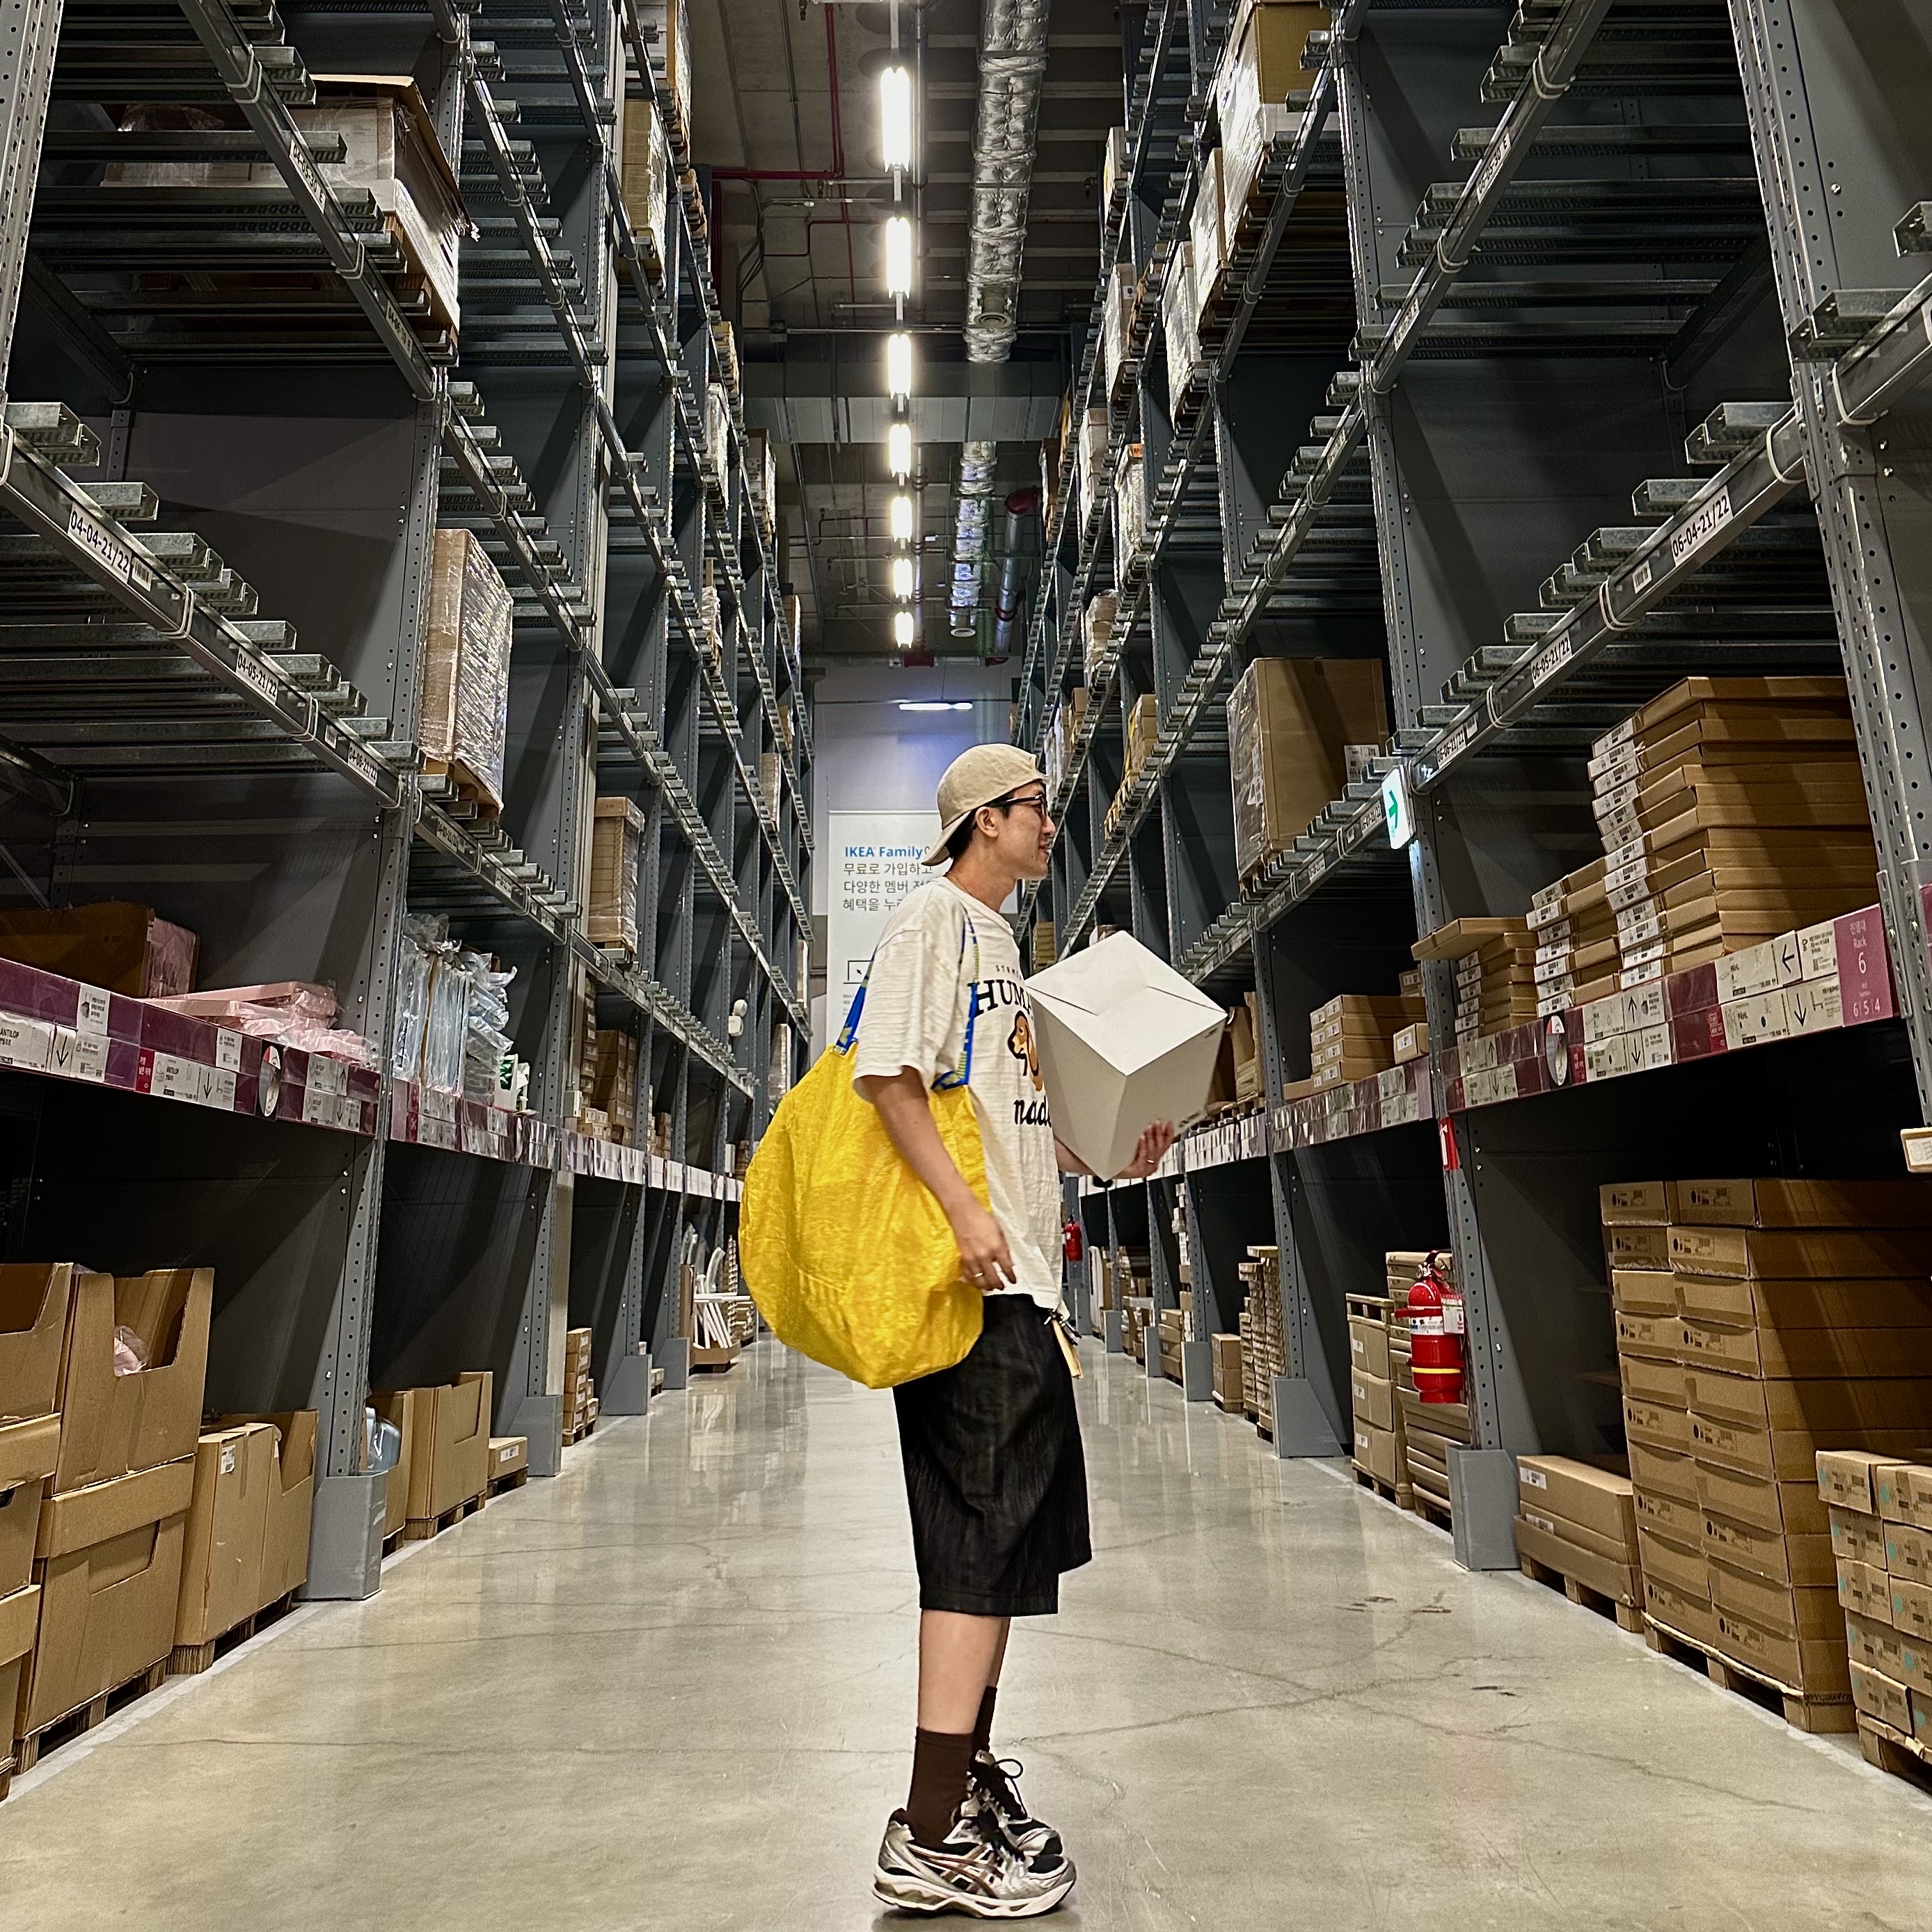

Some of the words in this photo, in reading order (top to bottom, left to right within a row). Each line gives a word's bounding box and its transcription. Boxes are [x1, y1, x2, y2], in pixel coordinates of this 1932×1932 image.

[292, 145, 317, 193] 04-05-30
[319, 188, 324, 204] E
[70, 510, 129, 574] 04-04-21/22
[1672, 495, 1729, 557] 06-04-21/22
[1532, 637, 1570, 680] 06-05-21/22
[237, 653, 277, 699] 04-05-21/22
[845, 846, 875, 857] IKEA
[843, 863, 880, 876] 무료로
[844, 880, 880, 894] 다양한
[885, 880, 908, 894] 멤버
[843, 898, 880, 912] 혜택을
[1853, 935, 1867, 949] Rack
[1858, 951, 1867, 974] 6
[967, 979, 1033, 1020] HUM
